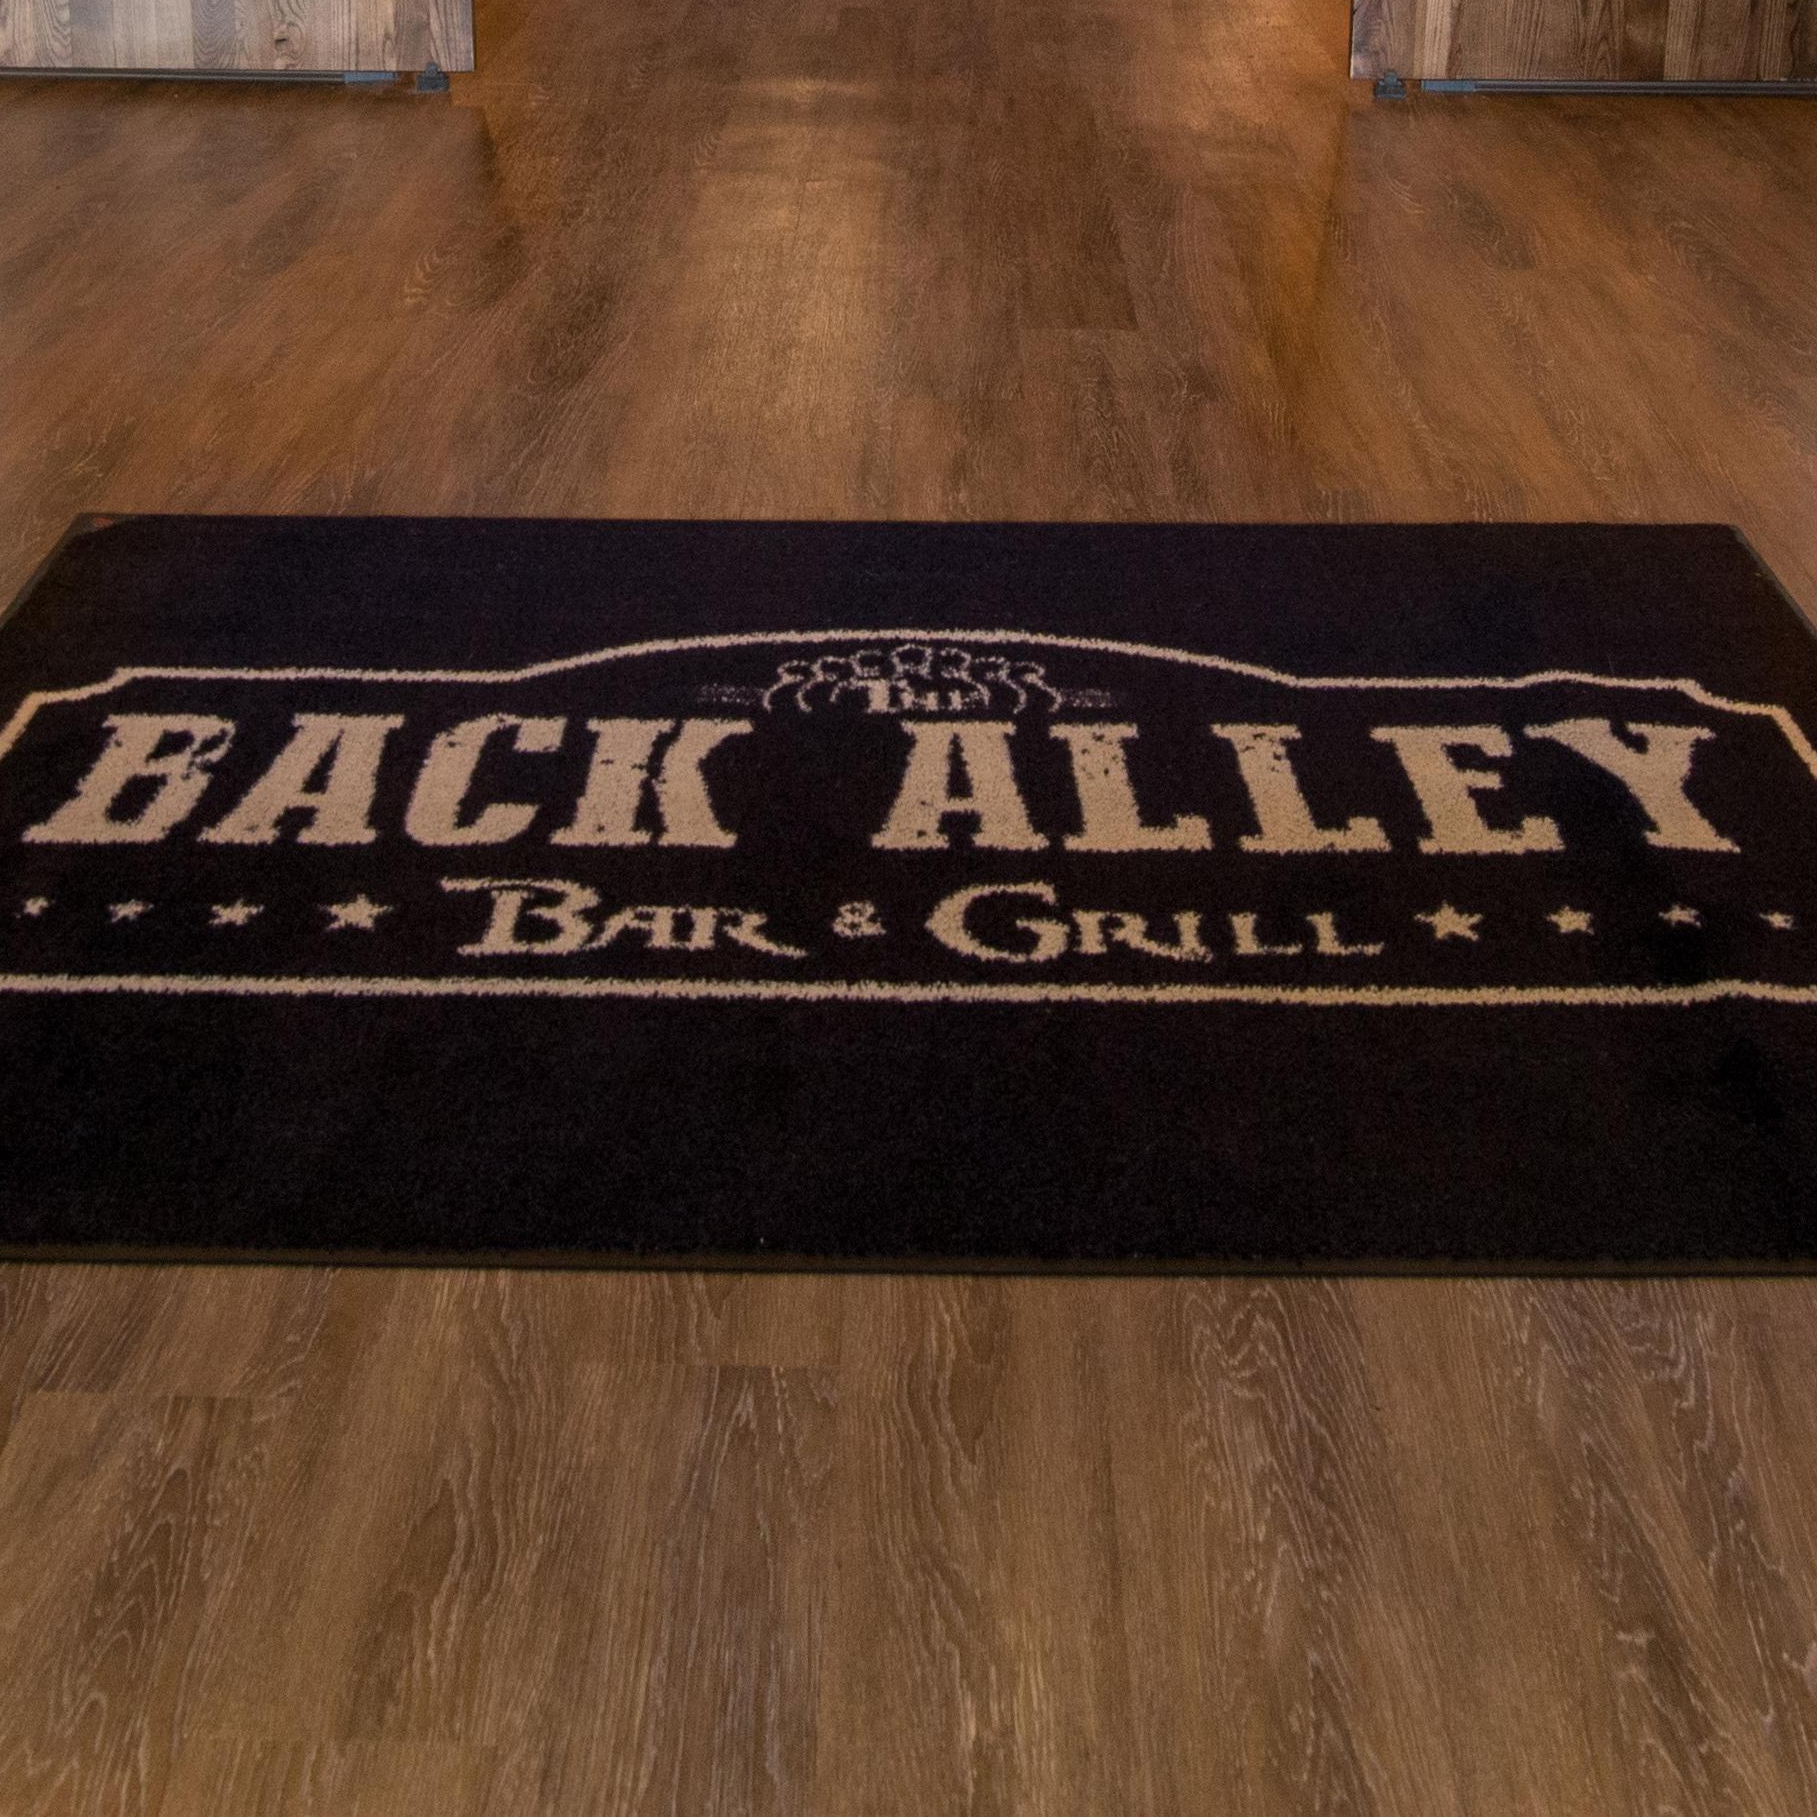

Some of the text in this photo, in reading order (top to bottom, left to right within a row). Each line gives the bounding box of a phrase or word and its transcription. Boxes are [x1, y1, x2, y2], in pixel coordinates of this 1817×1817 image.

[21, 713, 1741, 853] BACK ALLEY
[831, 900, 886, 938] &
